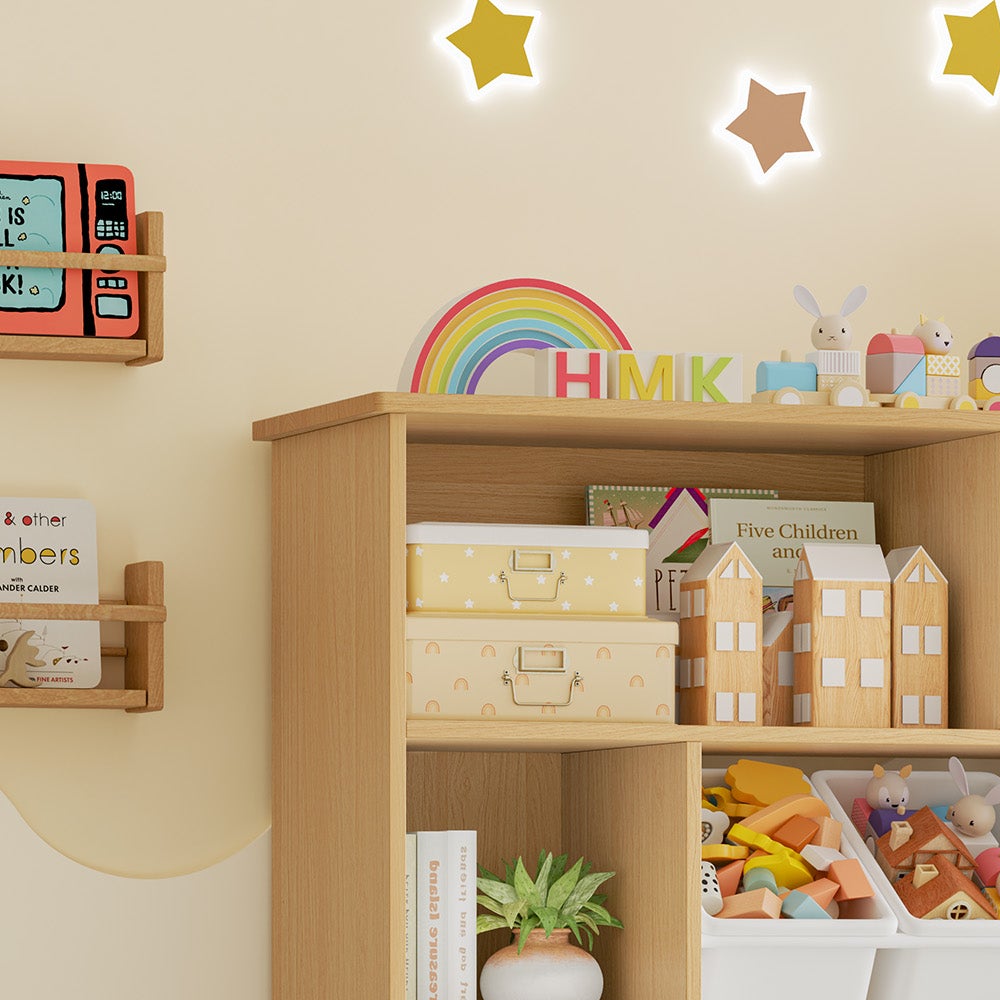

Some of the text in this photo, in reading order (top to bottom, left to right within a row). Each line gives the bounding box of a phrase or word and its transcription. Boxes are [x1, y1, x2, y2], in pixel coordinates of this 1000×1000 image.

[101, 190, 122, 200] 12:00
[8, 207, 25, 225] IS
[22, 513, 67, 527] other
[737, 522, 859, 540] Five Children
[27, 584, 60, 593] CALDER
[654, 568, 688, 611] PE
